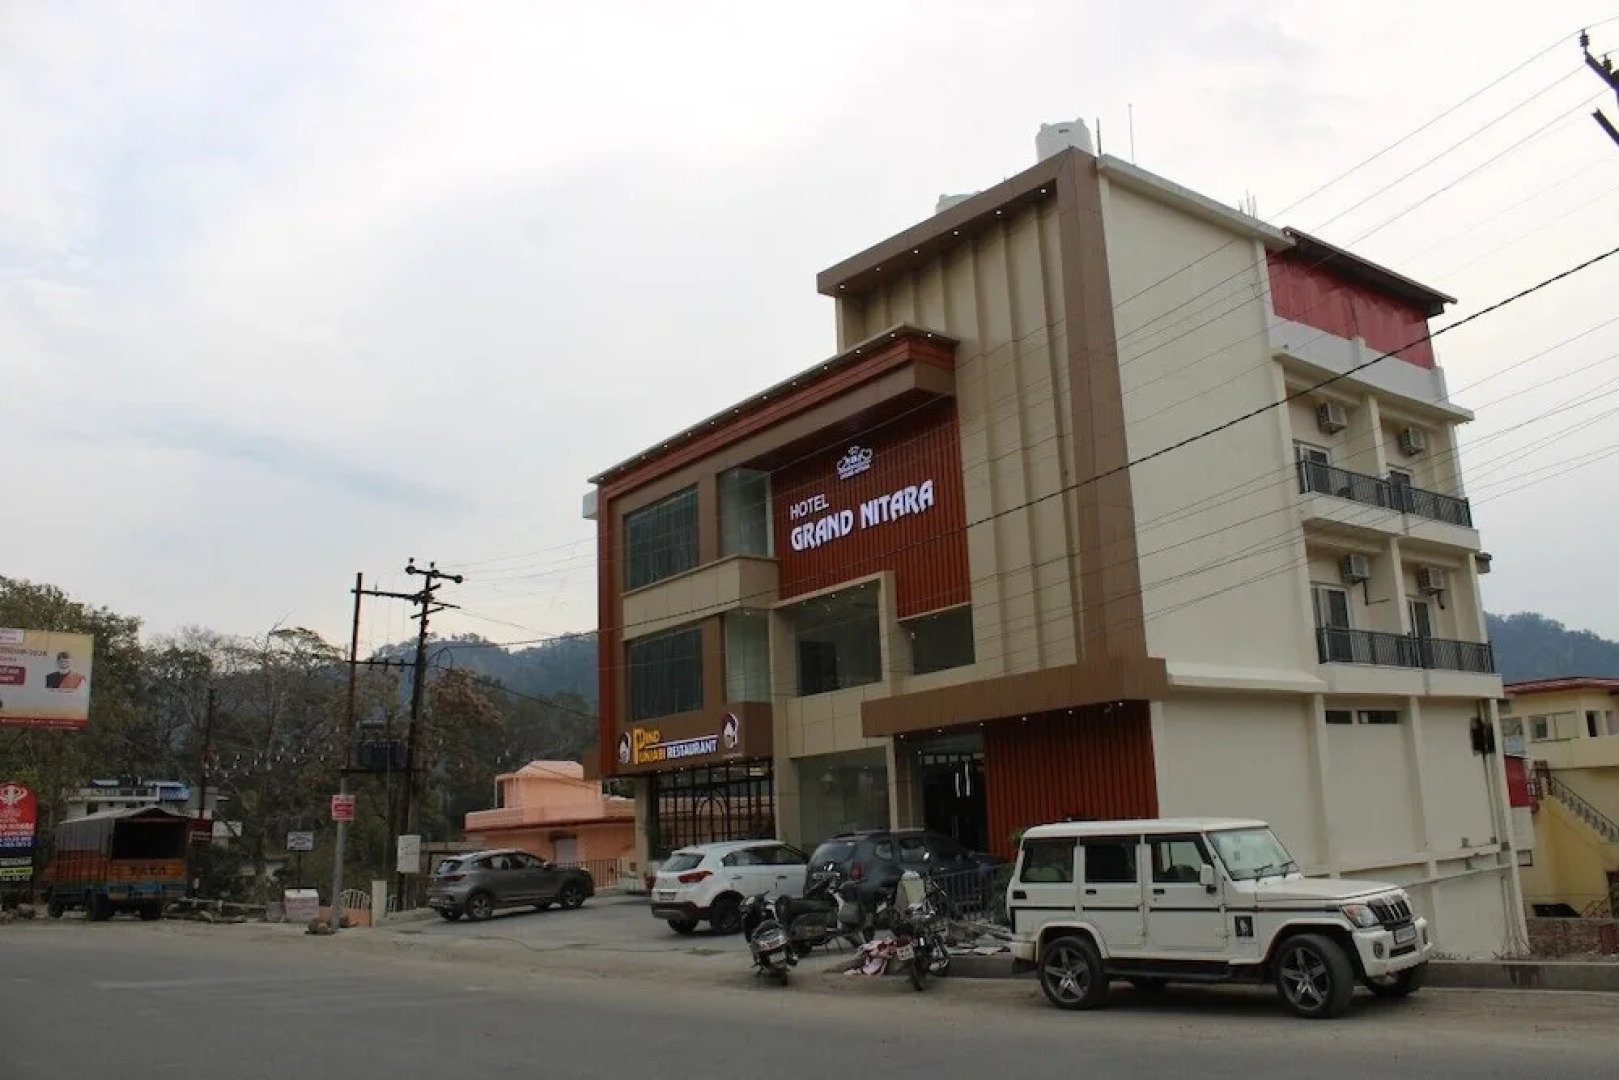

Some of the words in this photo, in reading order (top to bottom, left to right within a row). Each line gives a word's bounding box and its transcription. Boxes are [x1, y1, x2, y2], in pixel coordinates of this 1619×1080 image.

[790, 494, 829, 520] HOTEL
[791, 510, 854, 551] GRAND
[860, 479, 934, 529] NITARA
[667, 739, 717, 759] RESTAURANT
